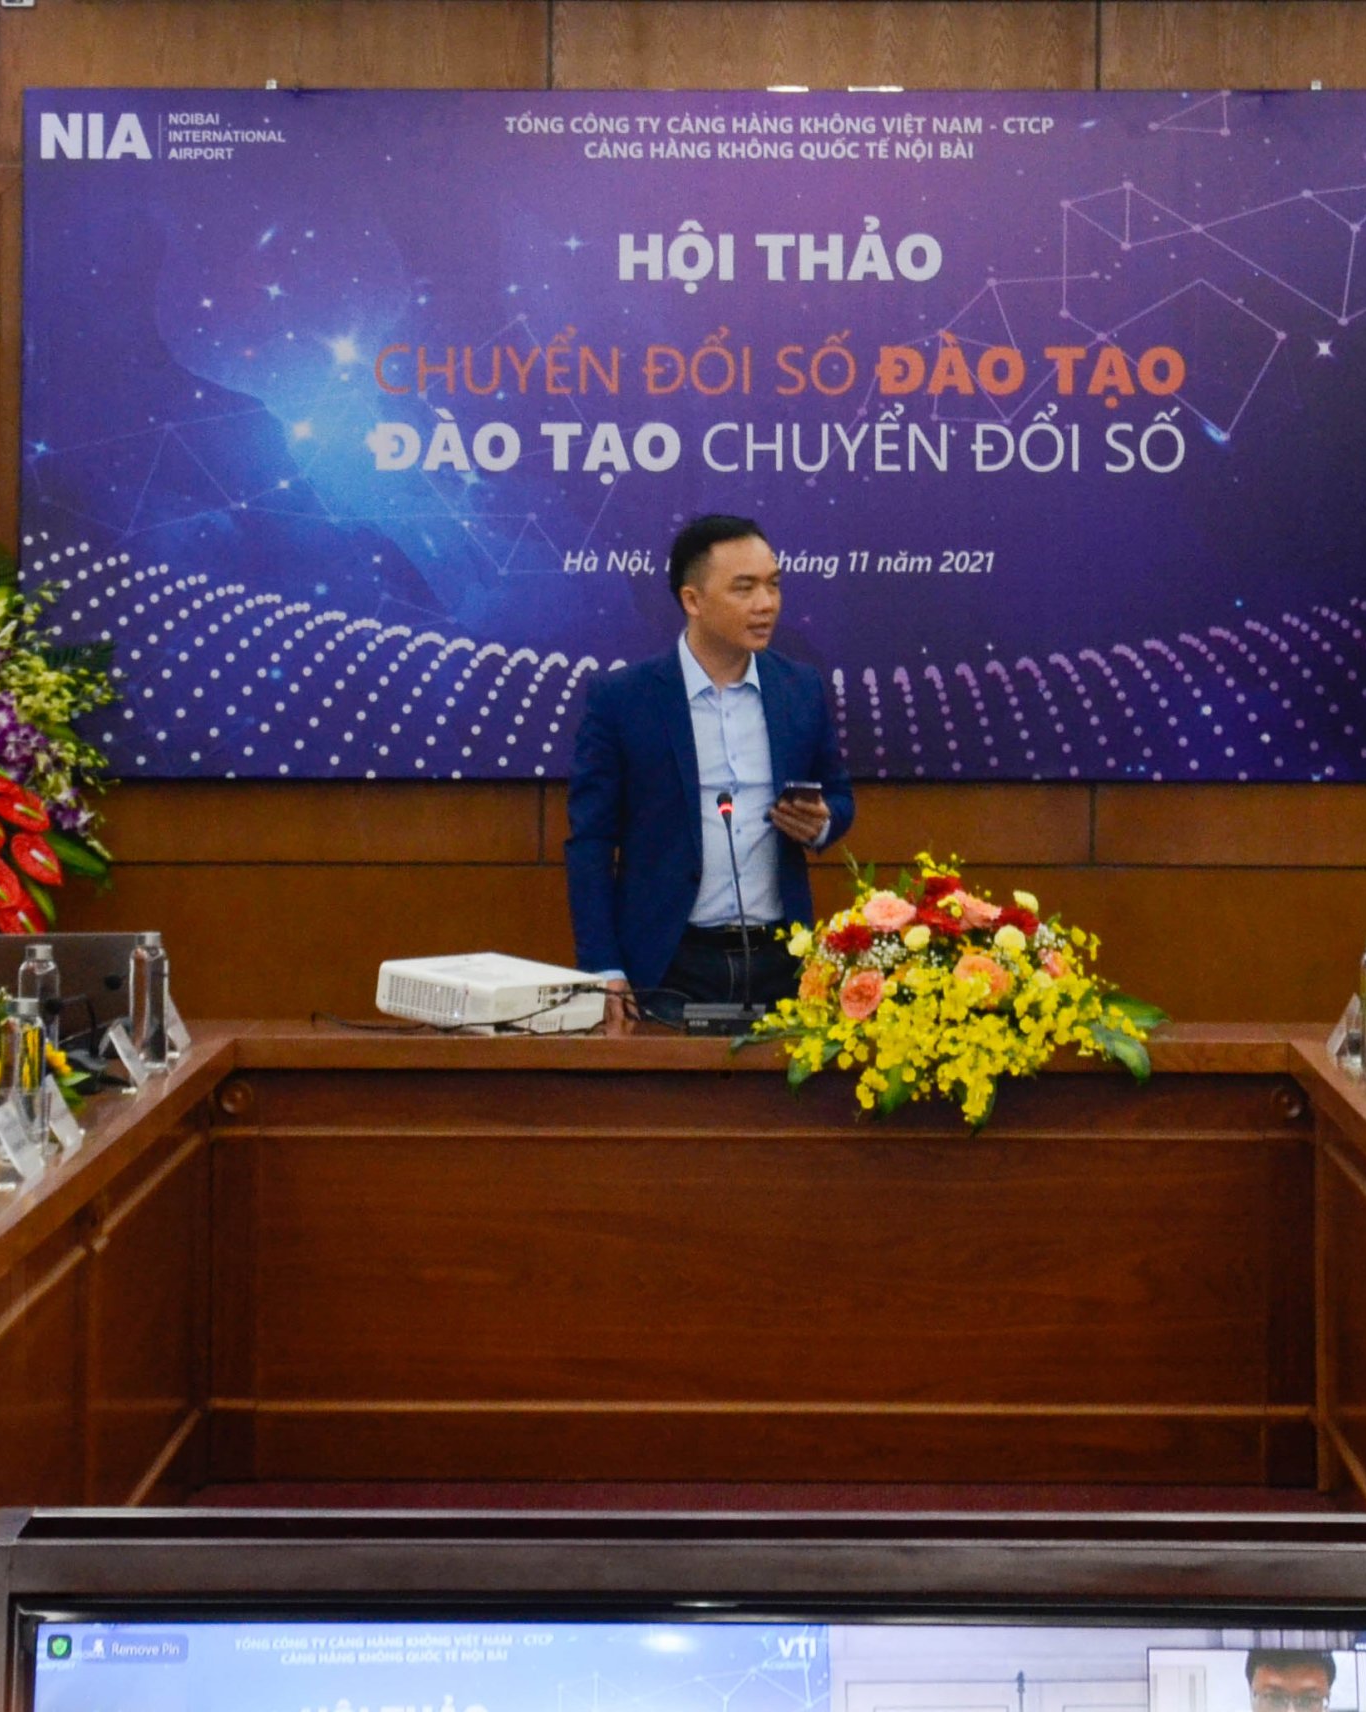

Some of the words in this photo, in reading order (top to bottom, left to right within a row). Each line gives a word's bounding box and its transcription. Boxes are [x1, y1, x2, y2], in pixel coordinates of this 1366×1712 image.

[169, 113, 219, 125] NOIBAI
[505, 111, 564, 134] TỔNG
[570, 113, 629, 134] CÔNG
[636, 117, 660, 134] TY
[667, 112, 725, 134] CẢNG
[732, 112, 793, 134] HÀNG
[800, 113, 876, 134] KHÔNG
[882, 113, 926, 137] VIỆT
[933, 117, 982, 134] NAM
[1003, 117, 1054, 134] CTCP
[41, 113, 152, 159] NIA
[169, 131, 285, 142] INTERNATIONAL
[168, 148, 234, 160] AIRPORT
[585, 137, 643, 159] CẢNG
[650, 137, 711, 159] HÀNG
[718, 138, 793, 159] KHÔNG
[799, 137, 859, 161] QUỐC
[865, 136, 890, 159] TẾ
[895, 138, 932, 162] NỘI
[940, 137, 974, 159] BÀI
[619, 220, 734, 294] HỘI
[756, 215, 943, 281] THẢO
[374, 324, 620, 394] CHUYỂN
[642, 325, 752, 394] ĐỔI
[776, 329, 857, 395] SỐ
[875, 330, 1026, 395] ĐÀO
[1044, 346, 1186, 409] TẠO
[368, 408, 521, 471] ĐÀO
[540, 422, 681, 485] TẠO
[702, 402, 948, 472] CHUYỂN
[971, 403, 1079, 472] ĐỔI
[1105, 407, 1186, 473] SỐ
[564, 551, 598, 573] Hà
[606, 551, 656, 576] Nội,
[848, 552, 869, 573] 11
[877, 551, 932, 573] năm
[939, 551, 994, 573] 2021
[112, 1642, 159, 1656] Remove
[162, 1642, 180, 1656] Pin
[778, 1636, 816, 1659] VTI
